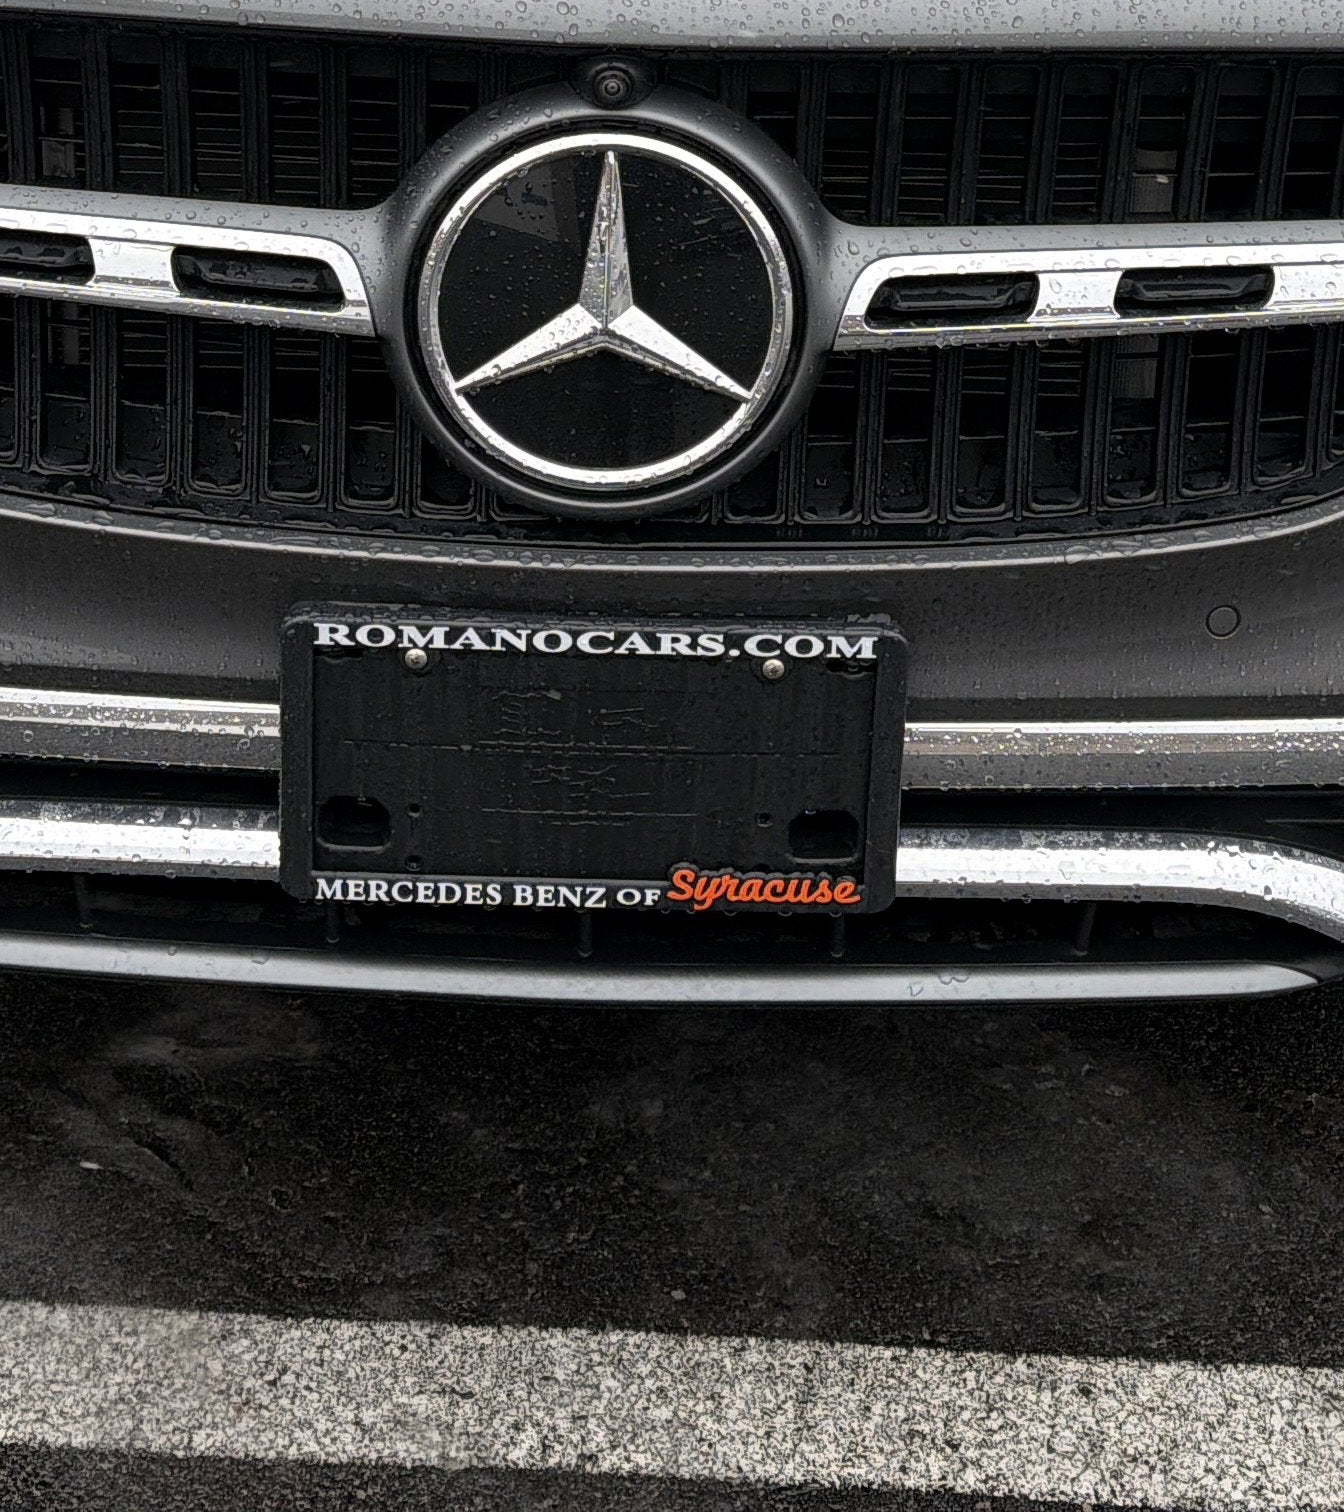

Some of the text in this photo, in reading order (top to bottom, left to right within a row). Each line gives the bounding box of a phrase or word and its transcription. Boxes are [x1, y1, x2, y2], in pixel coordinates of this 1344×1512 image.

[312, 621, 878, 660] ROMANOCARS.COM
[314, 869, 862, 910] MERCEDES BENZ OF Syracuse
